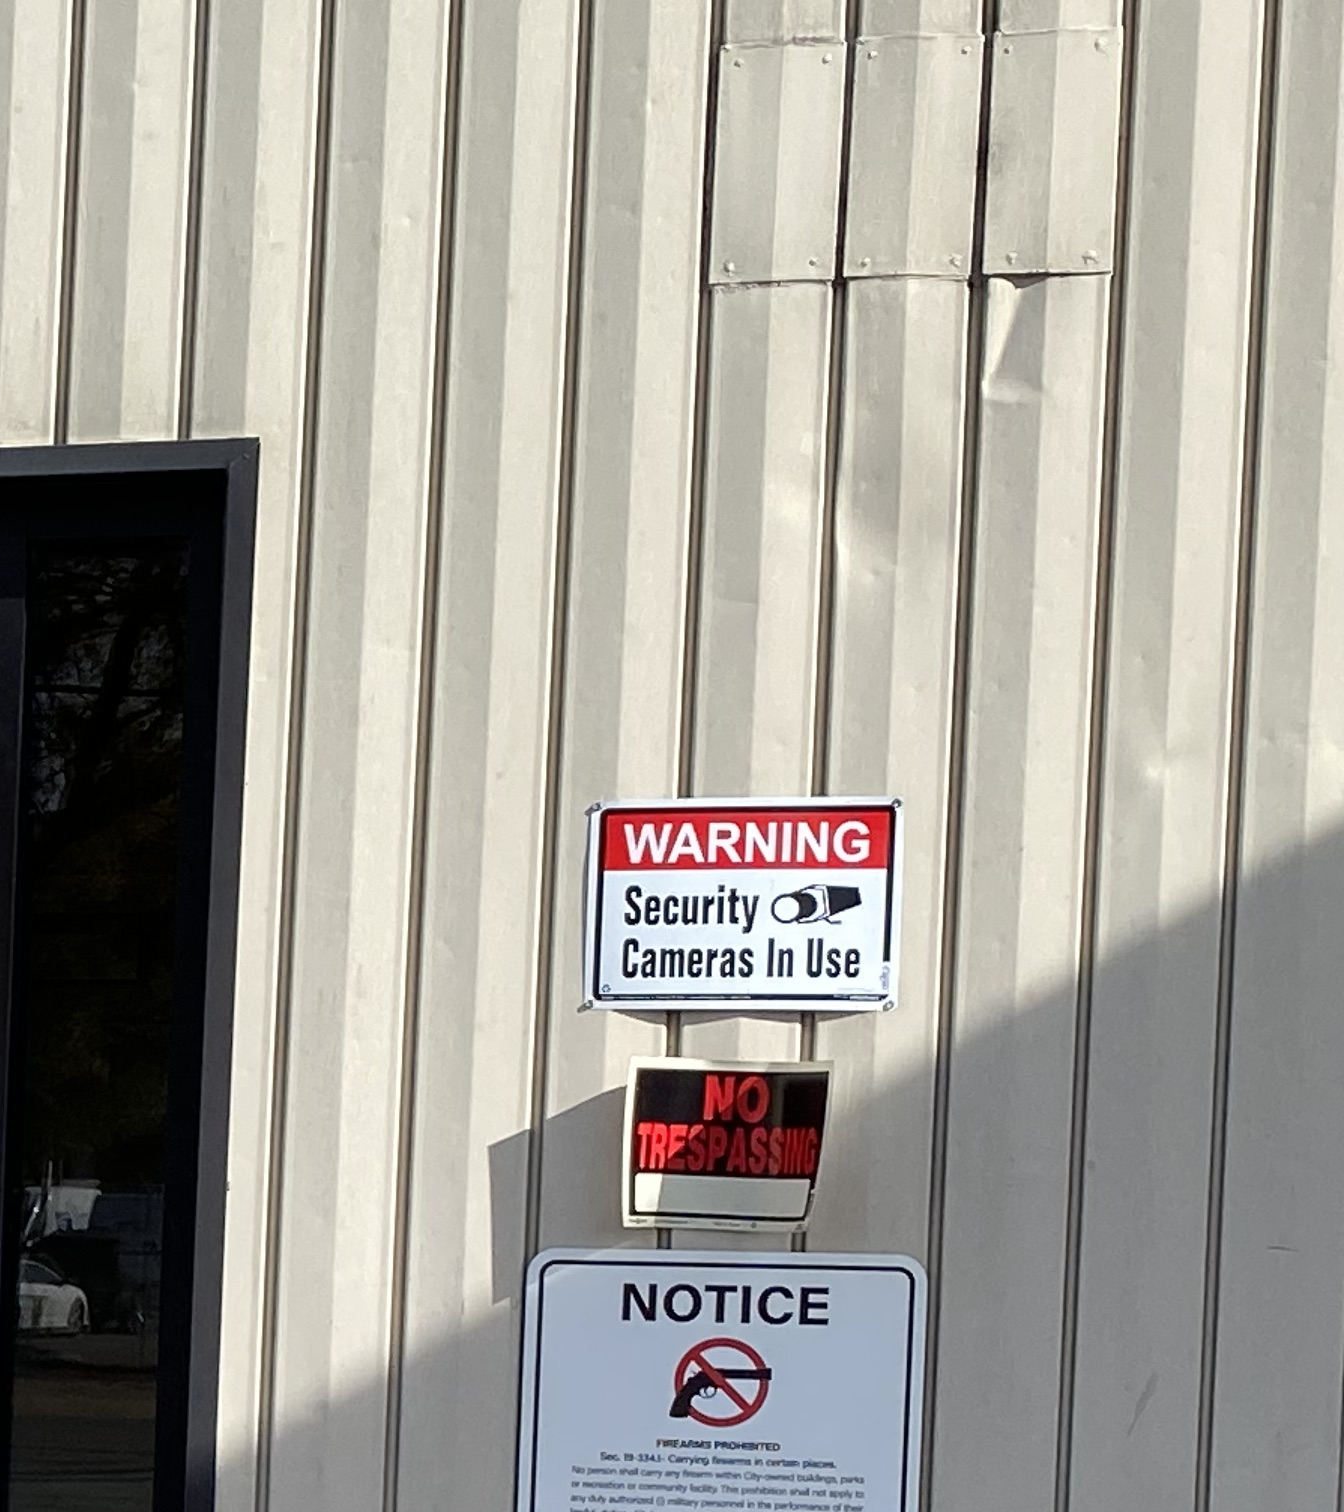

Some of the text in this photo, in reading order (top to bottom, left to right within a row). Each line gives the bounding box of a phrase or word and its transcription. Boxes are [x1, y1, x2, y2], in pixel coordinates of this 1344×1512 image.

[624, 820, 871, 864] WARNING
[624, 884, 760, 934] Security
[622, 937, 754, 979] Cameras
[766, 937, 794, 978] In
[806, 938, 861, 979] Use
[702, 1075, 770, 1122] NO
[636, 1121, 819, 1176] TRESPASSING
[620, 1282, 831, 1326] NOTICE
